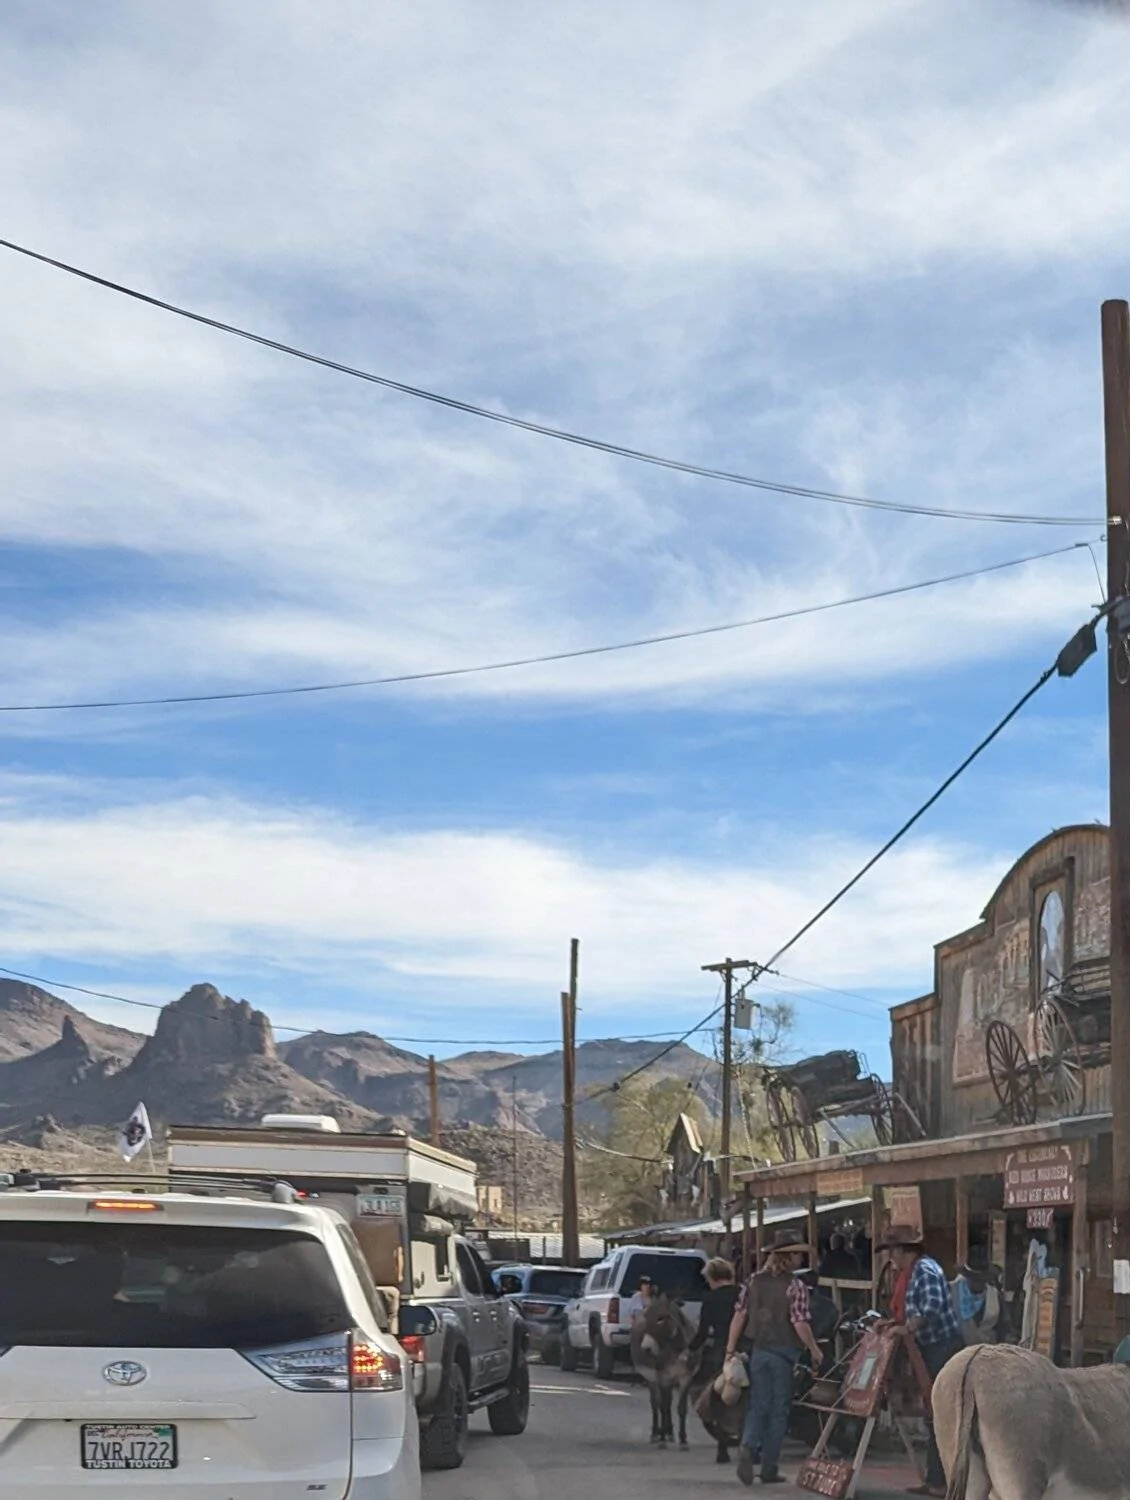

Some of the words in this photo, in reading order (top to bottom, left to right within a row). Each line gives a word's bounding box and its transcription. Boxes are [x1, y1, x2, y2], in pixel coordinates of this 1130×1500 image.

[87, 1441, 170, 1460] 7VRJ722
[86, 1460, 126, 1468] TUSTIN
[128, 1460, 172, 1468] TOYOTA
